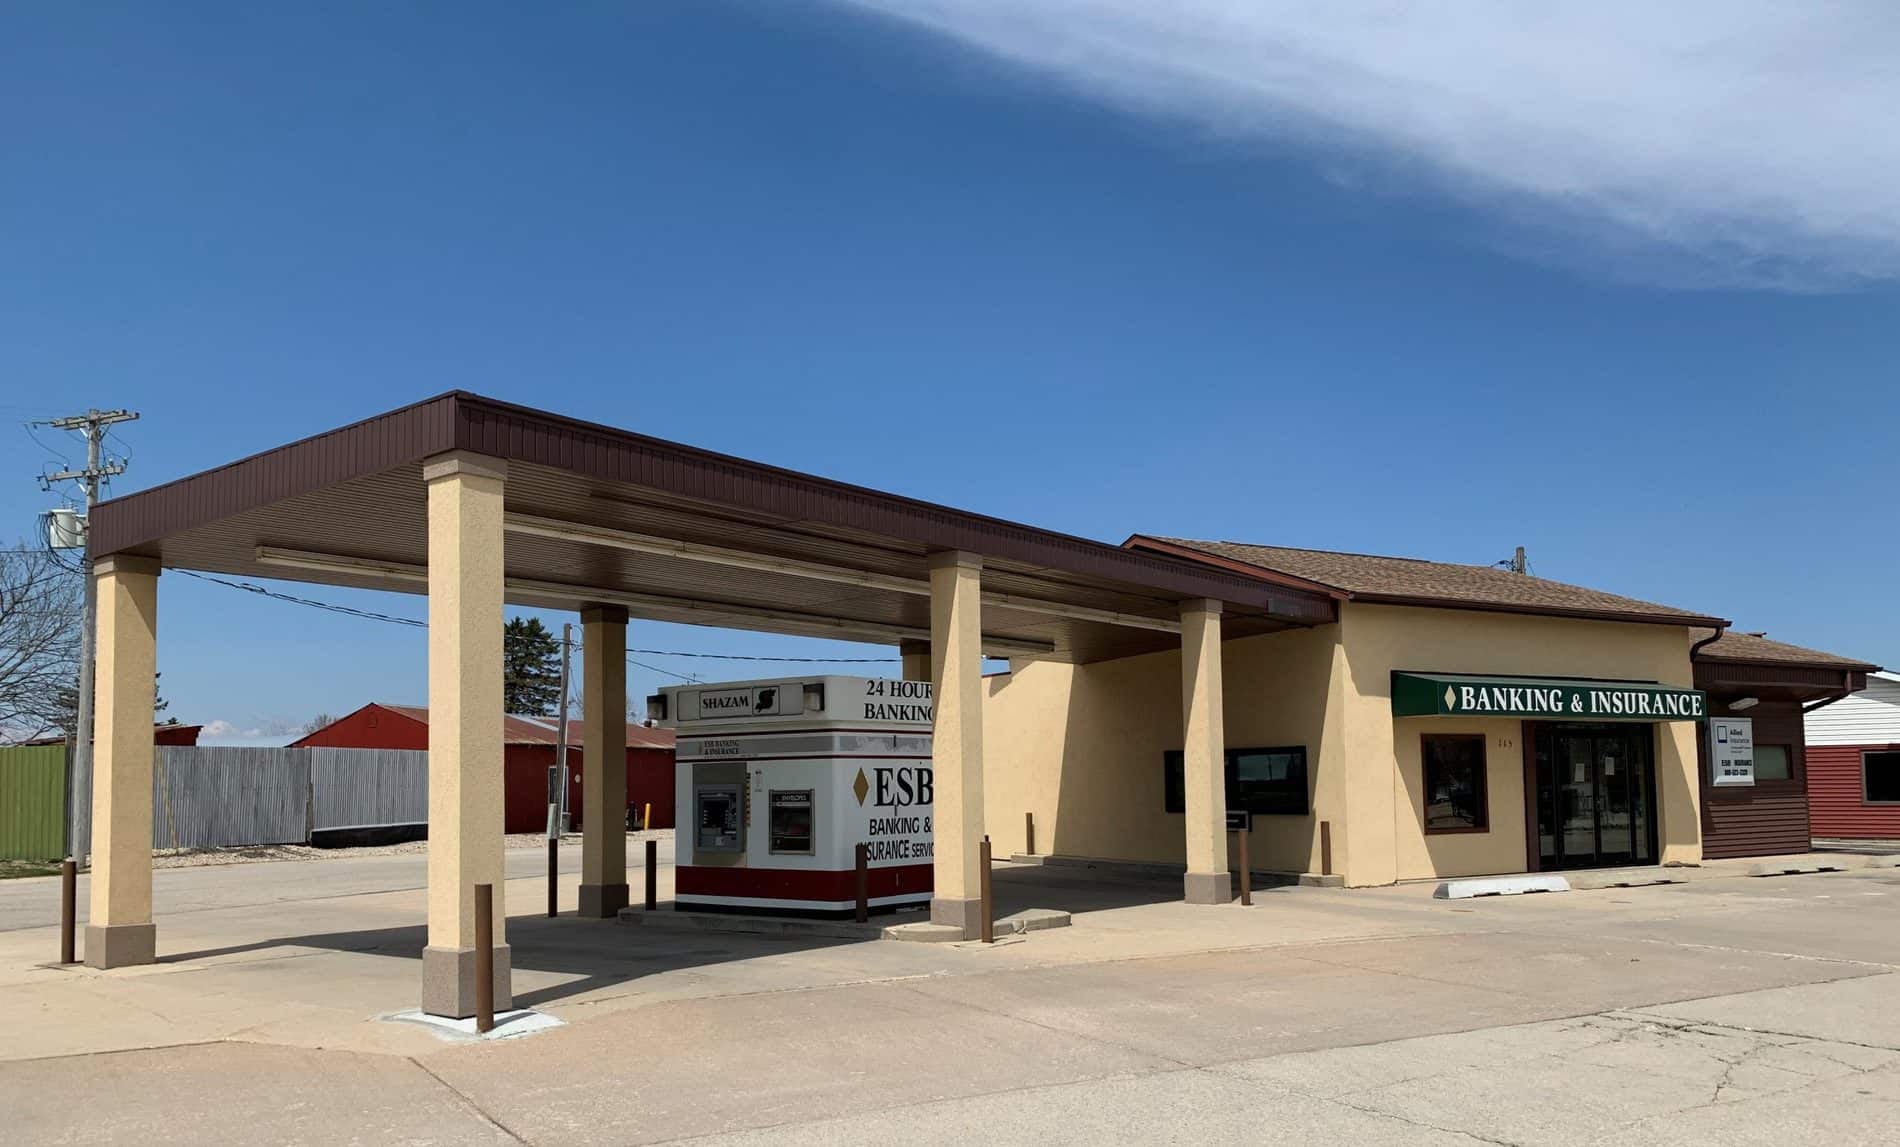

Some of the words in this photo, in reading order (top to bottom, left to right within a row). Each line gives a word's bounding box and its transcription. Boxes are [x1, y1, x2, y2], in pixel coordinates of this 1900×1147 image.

[866, 680, 884, 696] 24
[890, 681, 933, 699] HOUR
[703, 696, 749, 709] SHAZAM
[1460, 686, 1564, 712] BANKING
[1571, 693, 1584, 713] &
[1590, 691, 1703, 716] INSURANCE
[873, 767, 934, 807] ESB
[869, 817, 920, 836] BANKING
[923, 816, 933, 833] &
[859, 840, 910, 861] SURANCE
[911, 842, 934, 858] SERVIC
